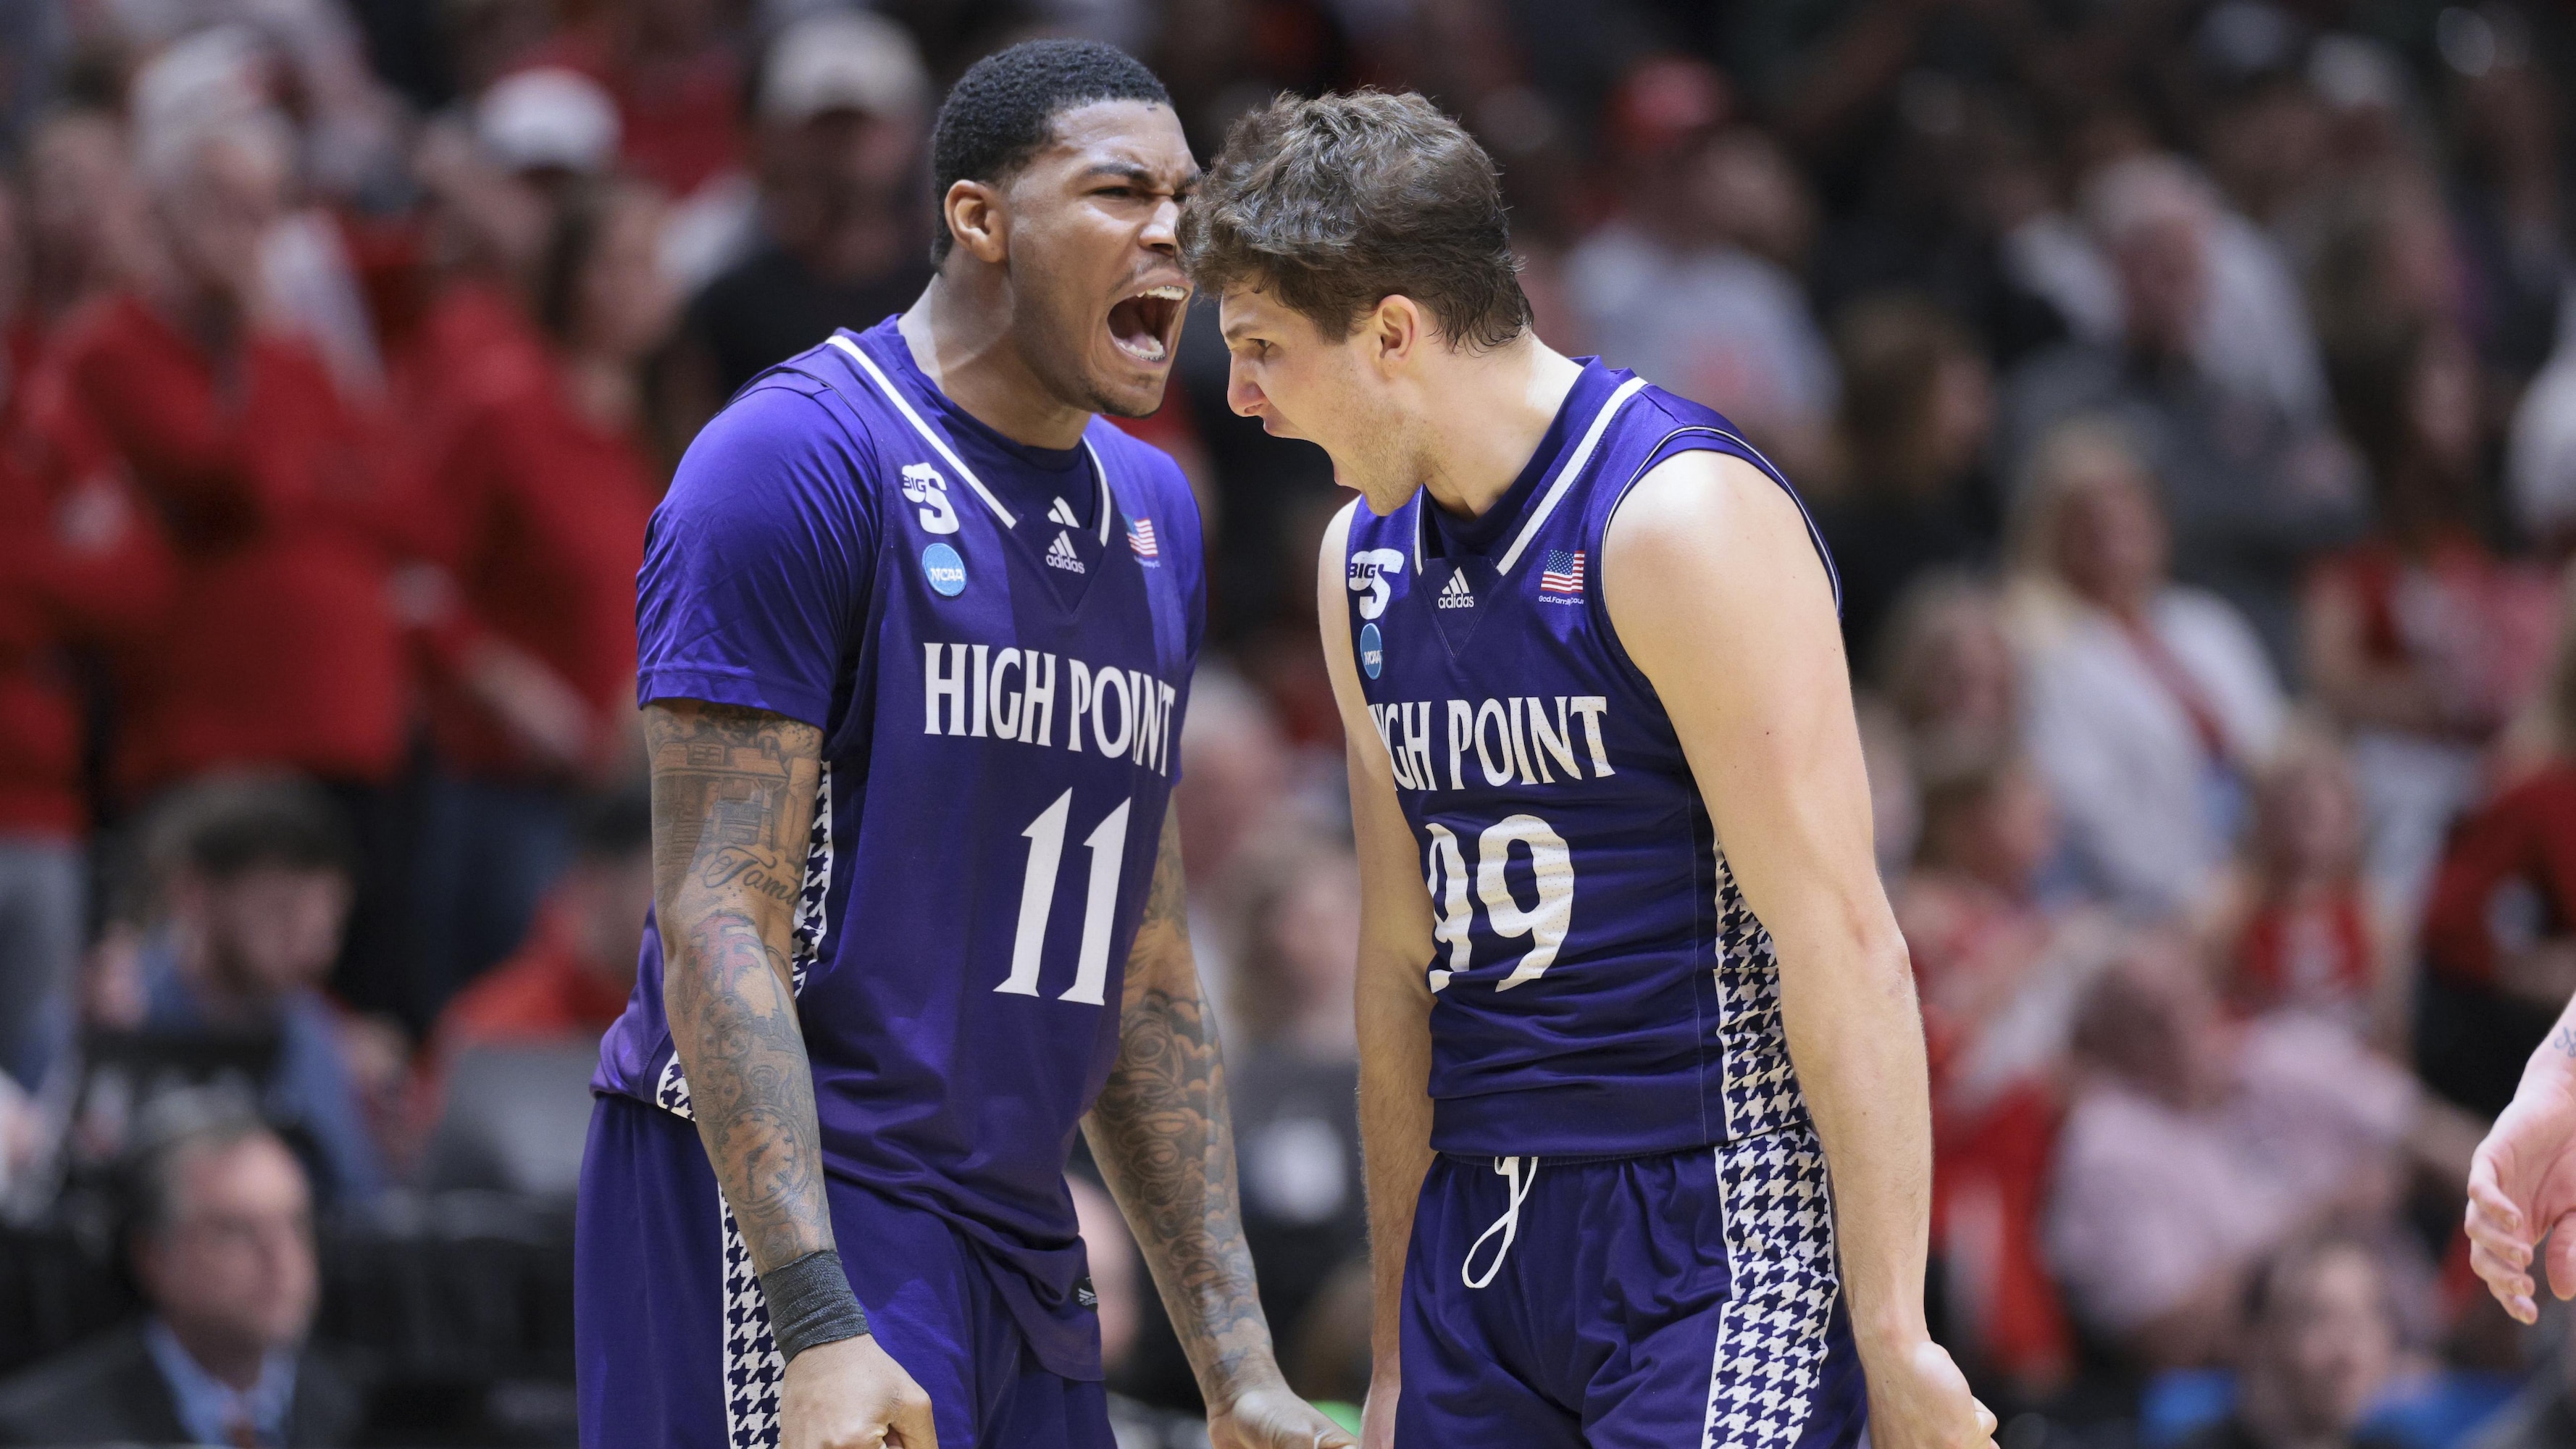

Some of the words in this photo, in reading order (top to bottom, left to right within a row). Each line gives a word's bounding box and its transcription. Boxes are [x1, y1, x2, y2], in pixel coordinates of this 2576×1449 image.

[902, 474, 926, 493] BIG
[1045, 553, 1085, 574] adidas
[1349, 562, 1376, 579] BIG
[929, 567, 964, 582] NCAA
[1438, 593, 1475, 609] adidas
[923, 642, 1057, 748] HIGH
[1066, 658, 1176, 777] POINT
[1447, 696, 1616, 791] POINT
[992, 786, 1132, 1006] 11
